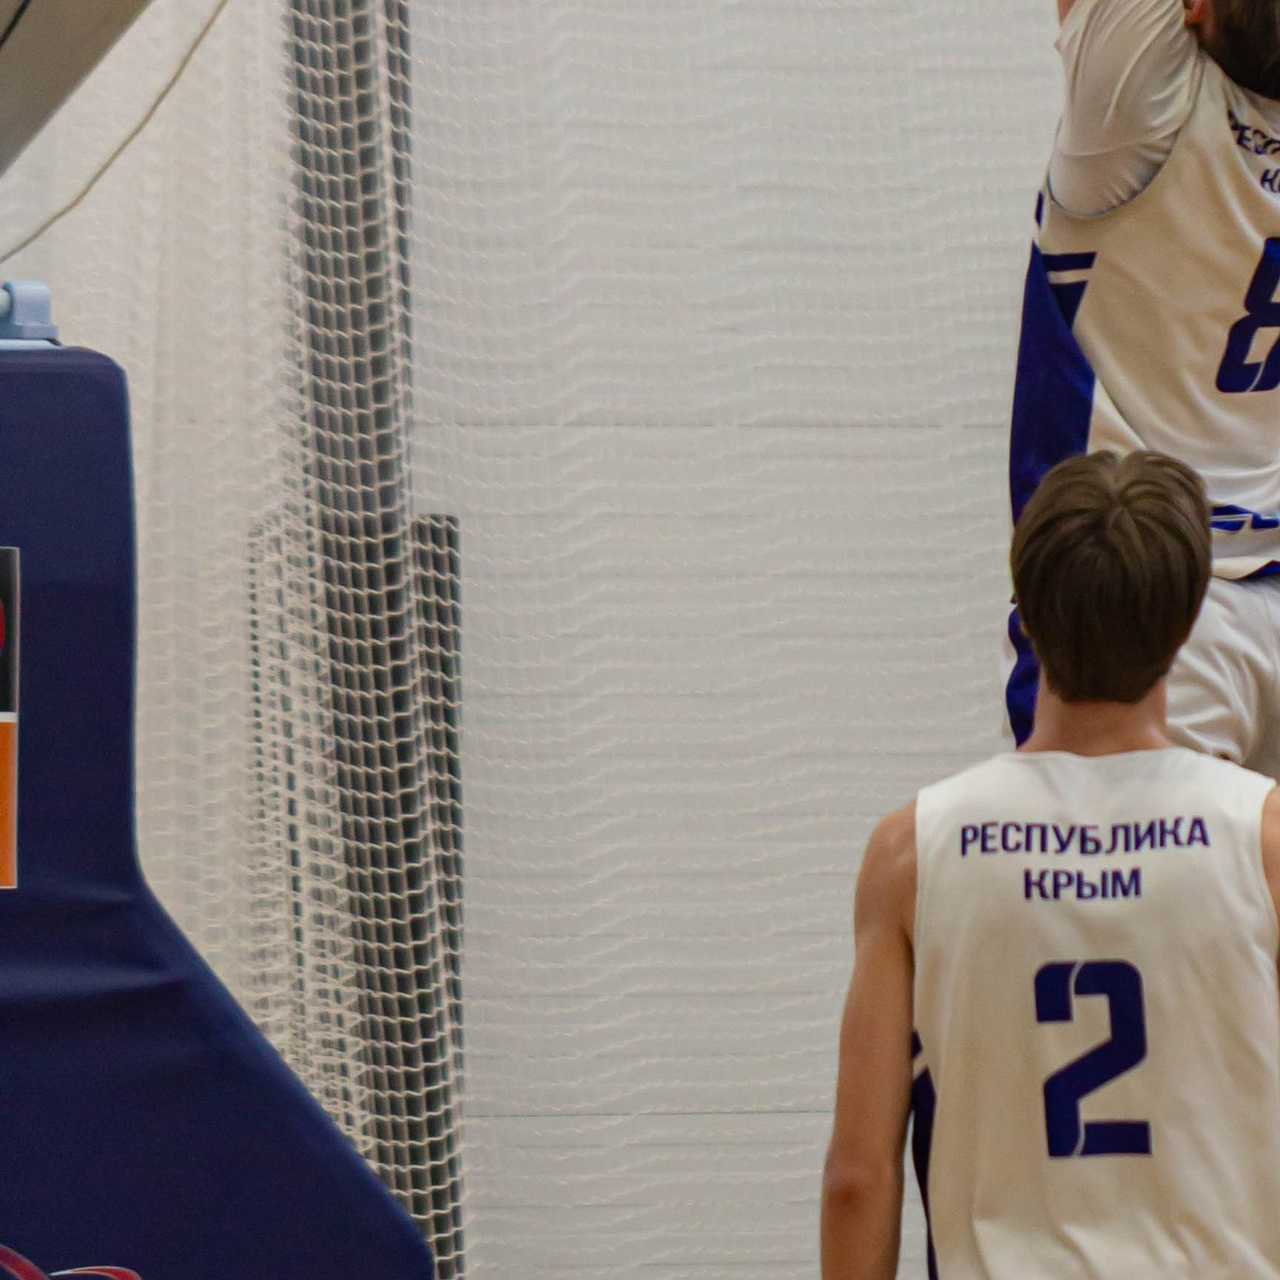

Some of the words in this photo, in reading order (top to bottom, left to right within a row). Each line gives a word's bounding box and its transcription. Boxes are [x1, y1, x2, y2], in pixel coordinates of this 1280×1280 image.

[960, 817, 1211, 857] РЕСПУБЛИКА
[1024, 866, 1143, 901] КРЫМ
[1033, 958, 1153, 1160] 2
